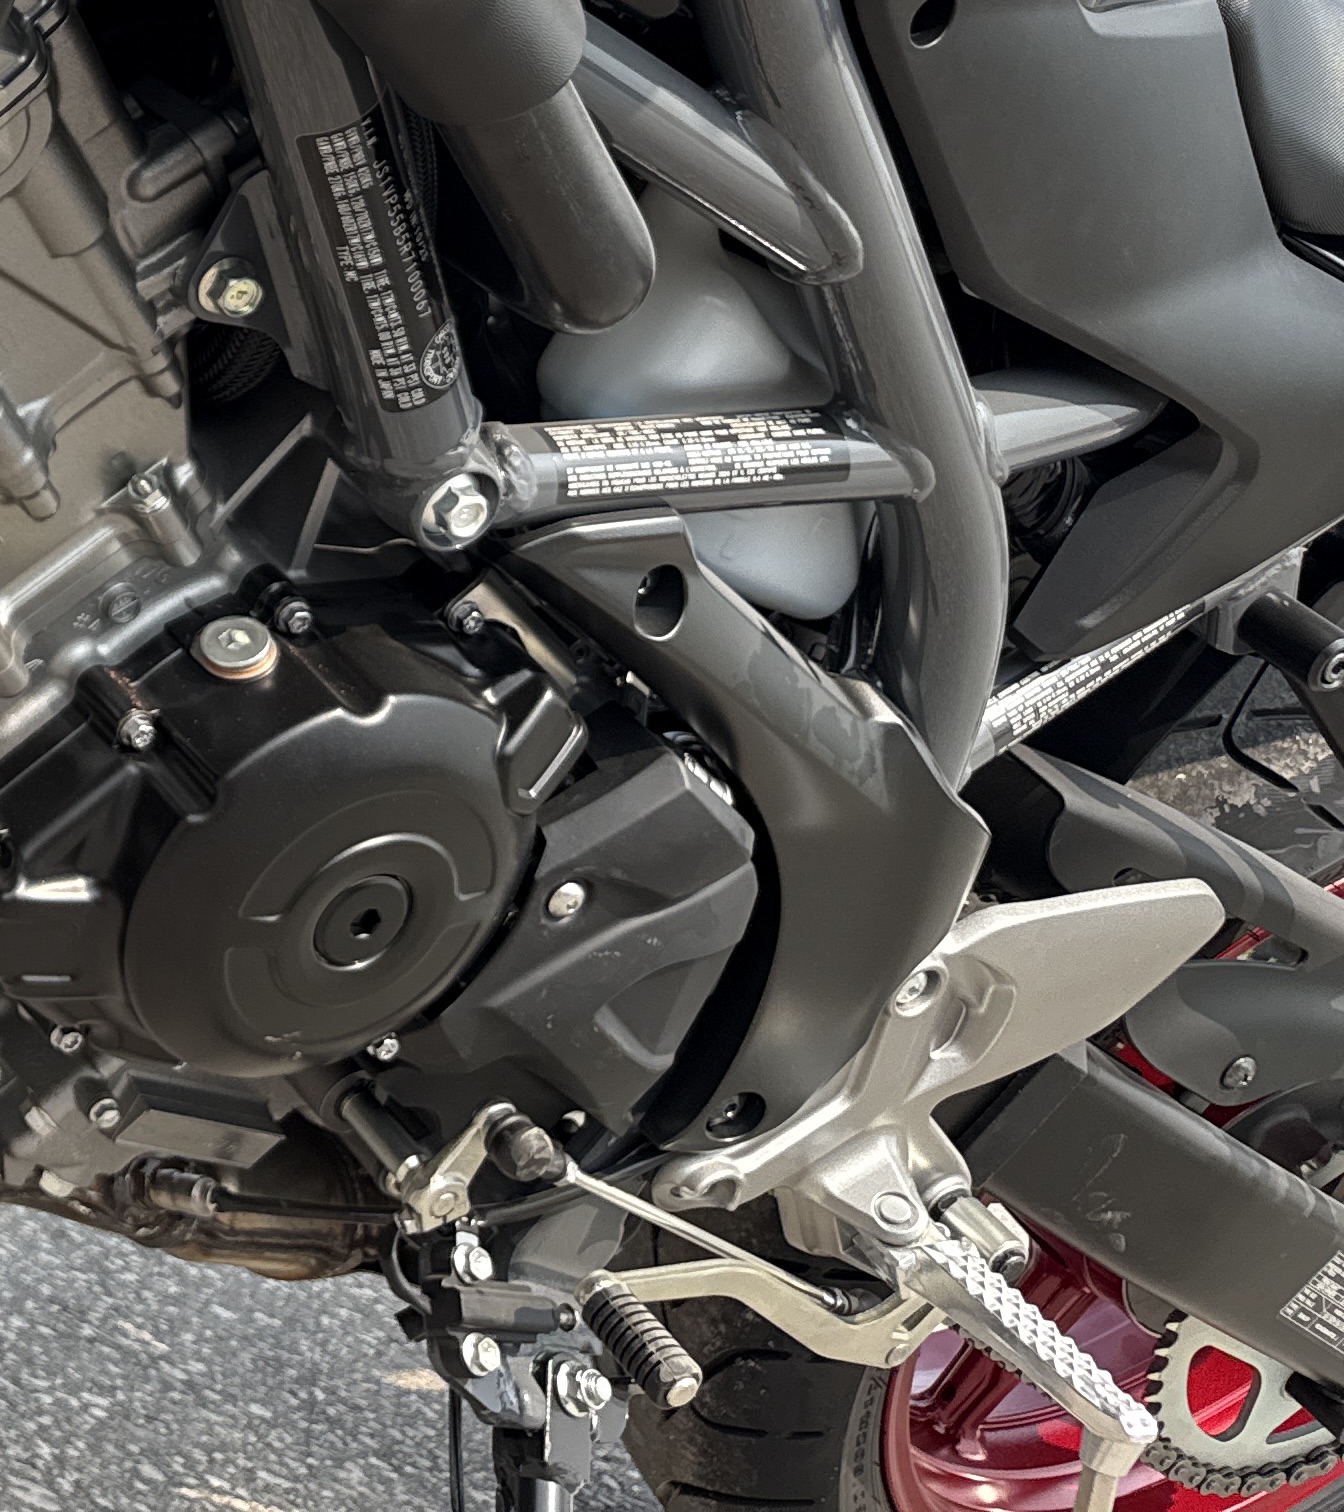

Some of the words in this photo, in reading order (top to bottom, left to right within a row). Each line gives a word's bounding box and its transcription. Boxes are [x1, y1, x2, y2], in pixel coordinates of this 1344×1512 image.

[374, 159, 432, 317] JS1VP55B5R7100067
[374, 366, 388, 379] IN
[377, 376, 395, 401] JAPAN
